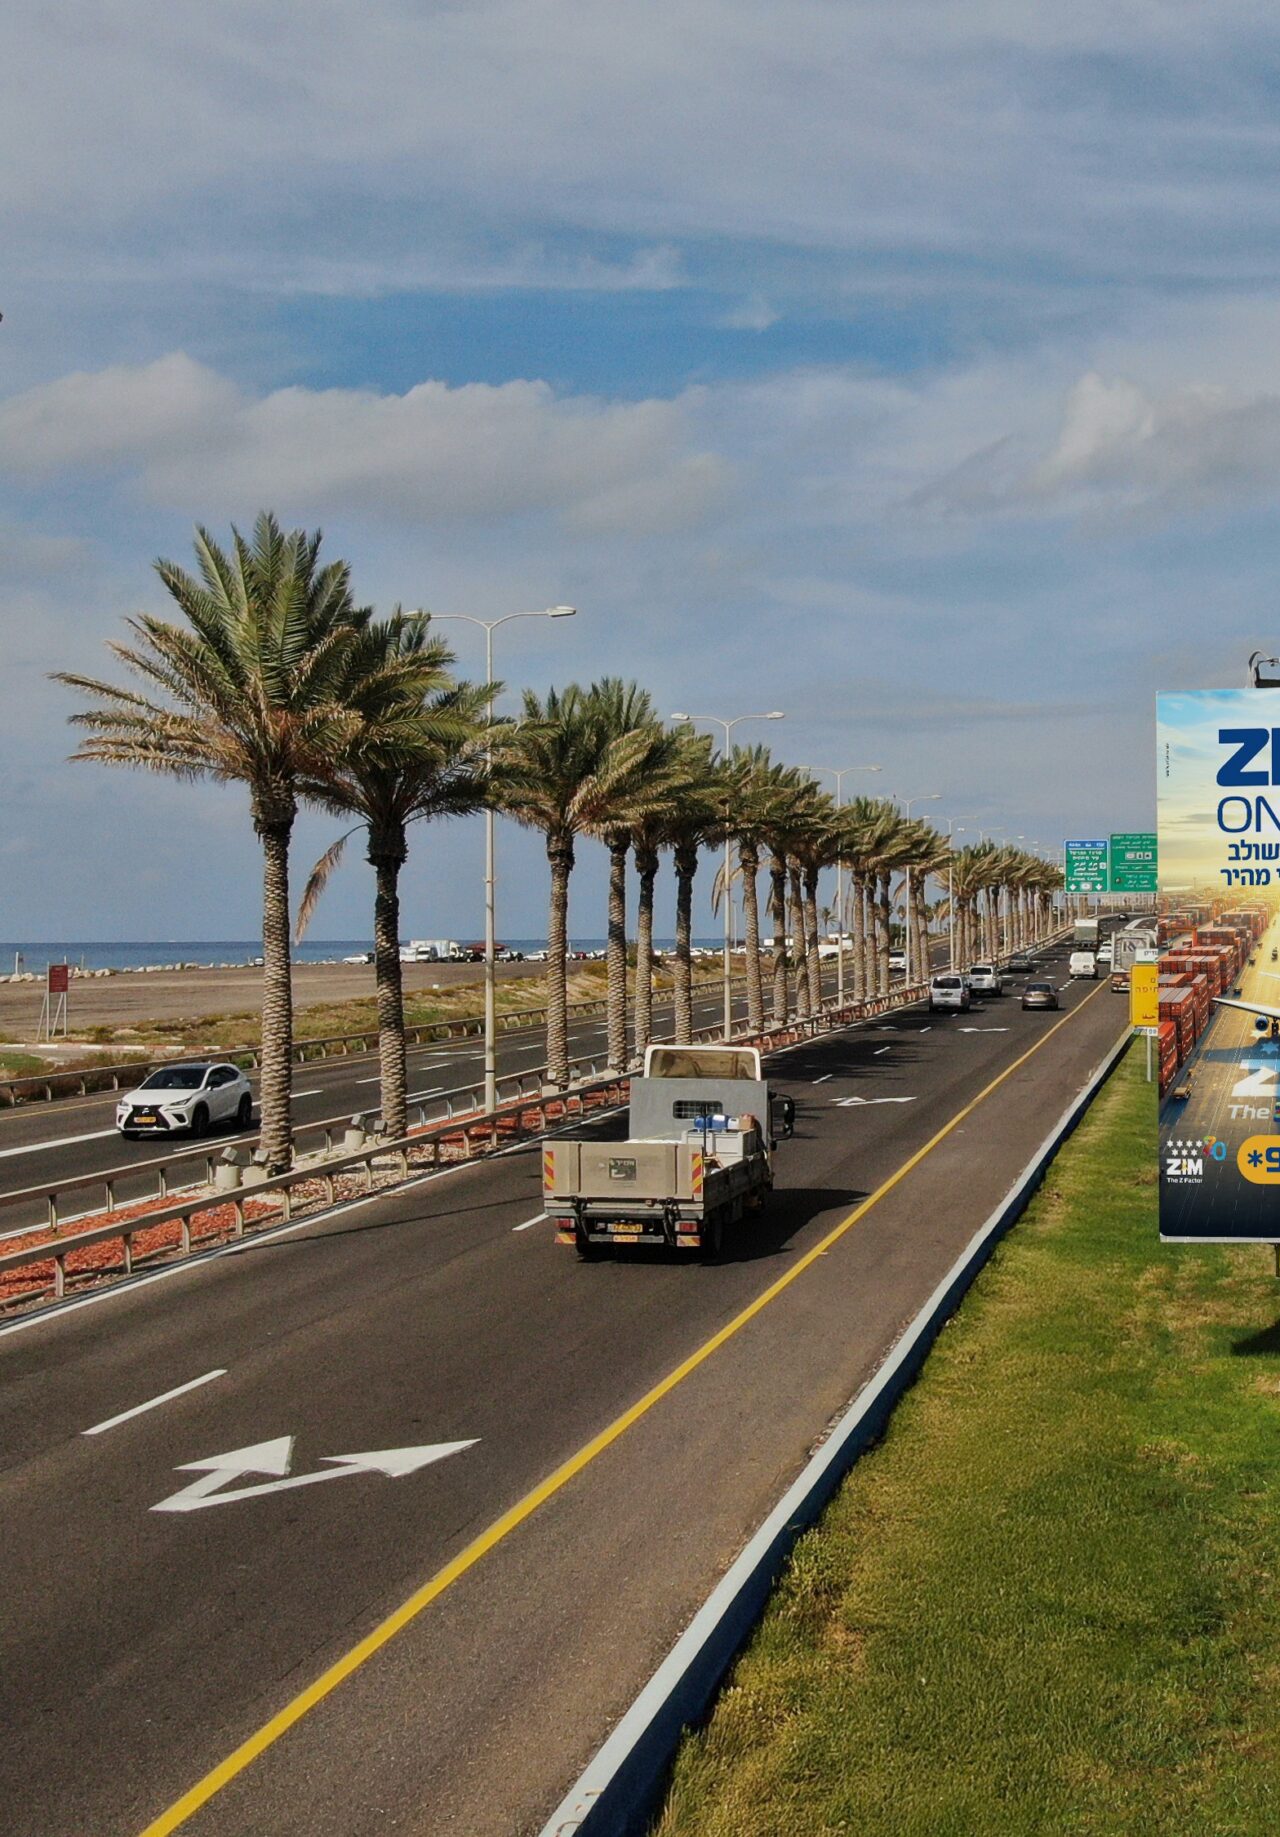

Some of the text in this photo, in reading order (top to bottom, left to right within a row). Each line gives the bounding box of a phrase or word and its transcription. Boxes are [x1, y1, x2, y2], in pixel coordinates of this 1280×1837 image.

[1220, 868, 1271, 886] מהיר
[1227, 1104, 1270, 1120] The
[1166, 1158, 1203, 1175] ZIM
